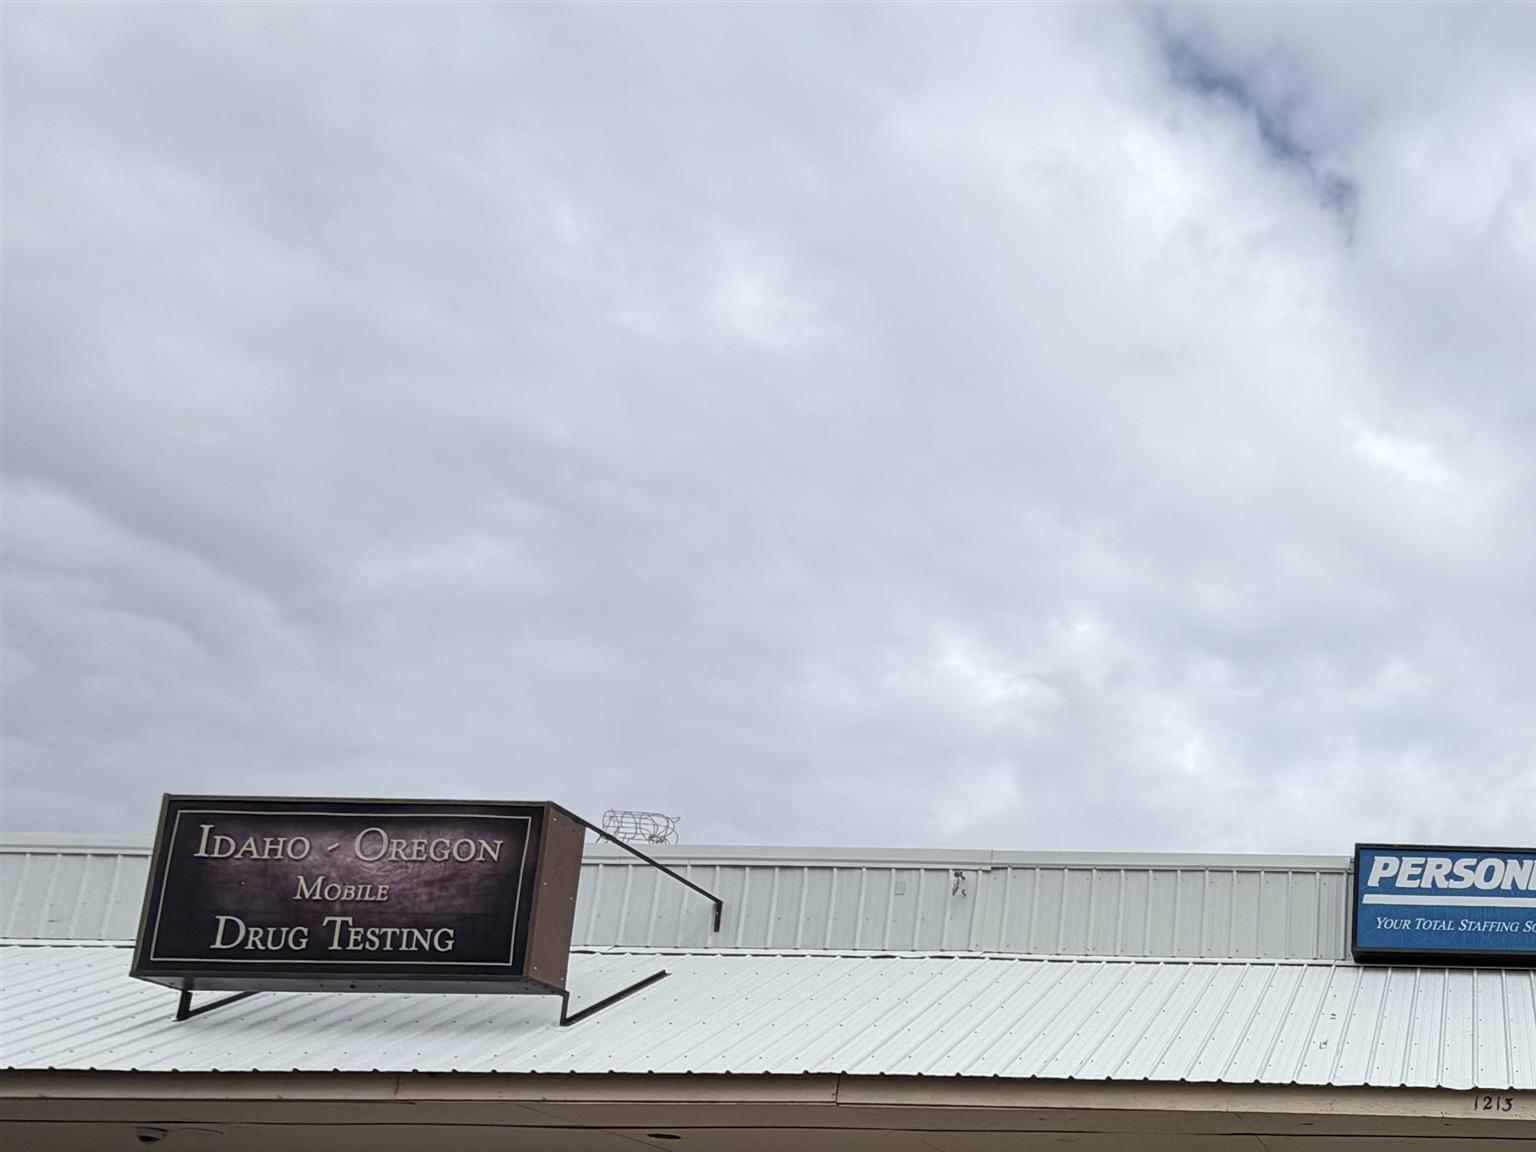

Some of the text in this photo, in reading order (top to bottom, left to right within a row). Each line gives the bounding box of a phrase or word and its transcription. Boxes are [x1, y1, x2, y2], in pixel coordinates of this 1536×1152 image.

[194, 825, 310, 860] IDAHO
[354, 827, 503, 863] OREGON
[293, 876, 390, 902] MOBILE
[210, 916, 455, 952] DRUG TESTING
[1376, 917, 1411, 930] YOUR
[1415, 918, 1455, 931] TOTAL
[1458, 919, 1519, 933] STAFFING
